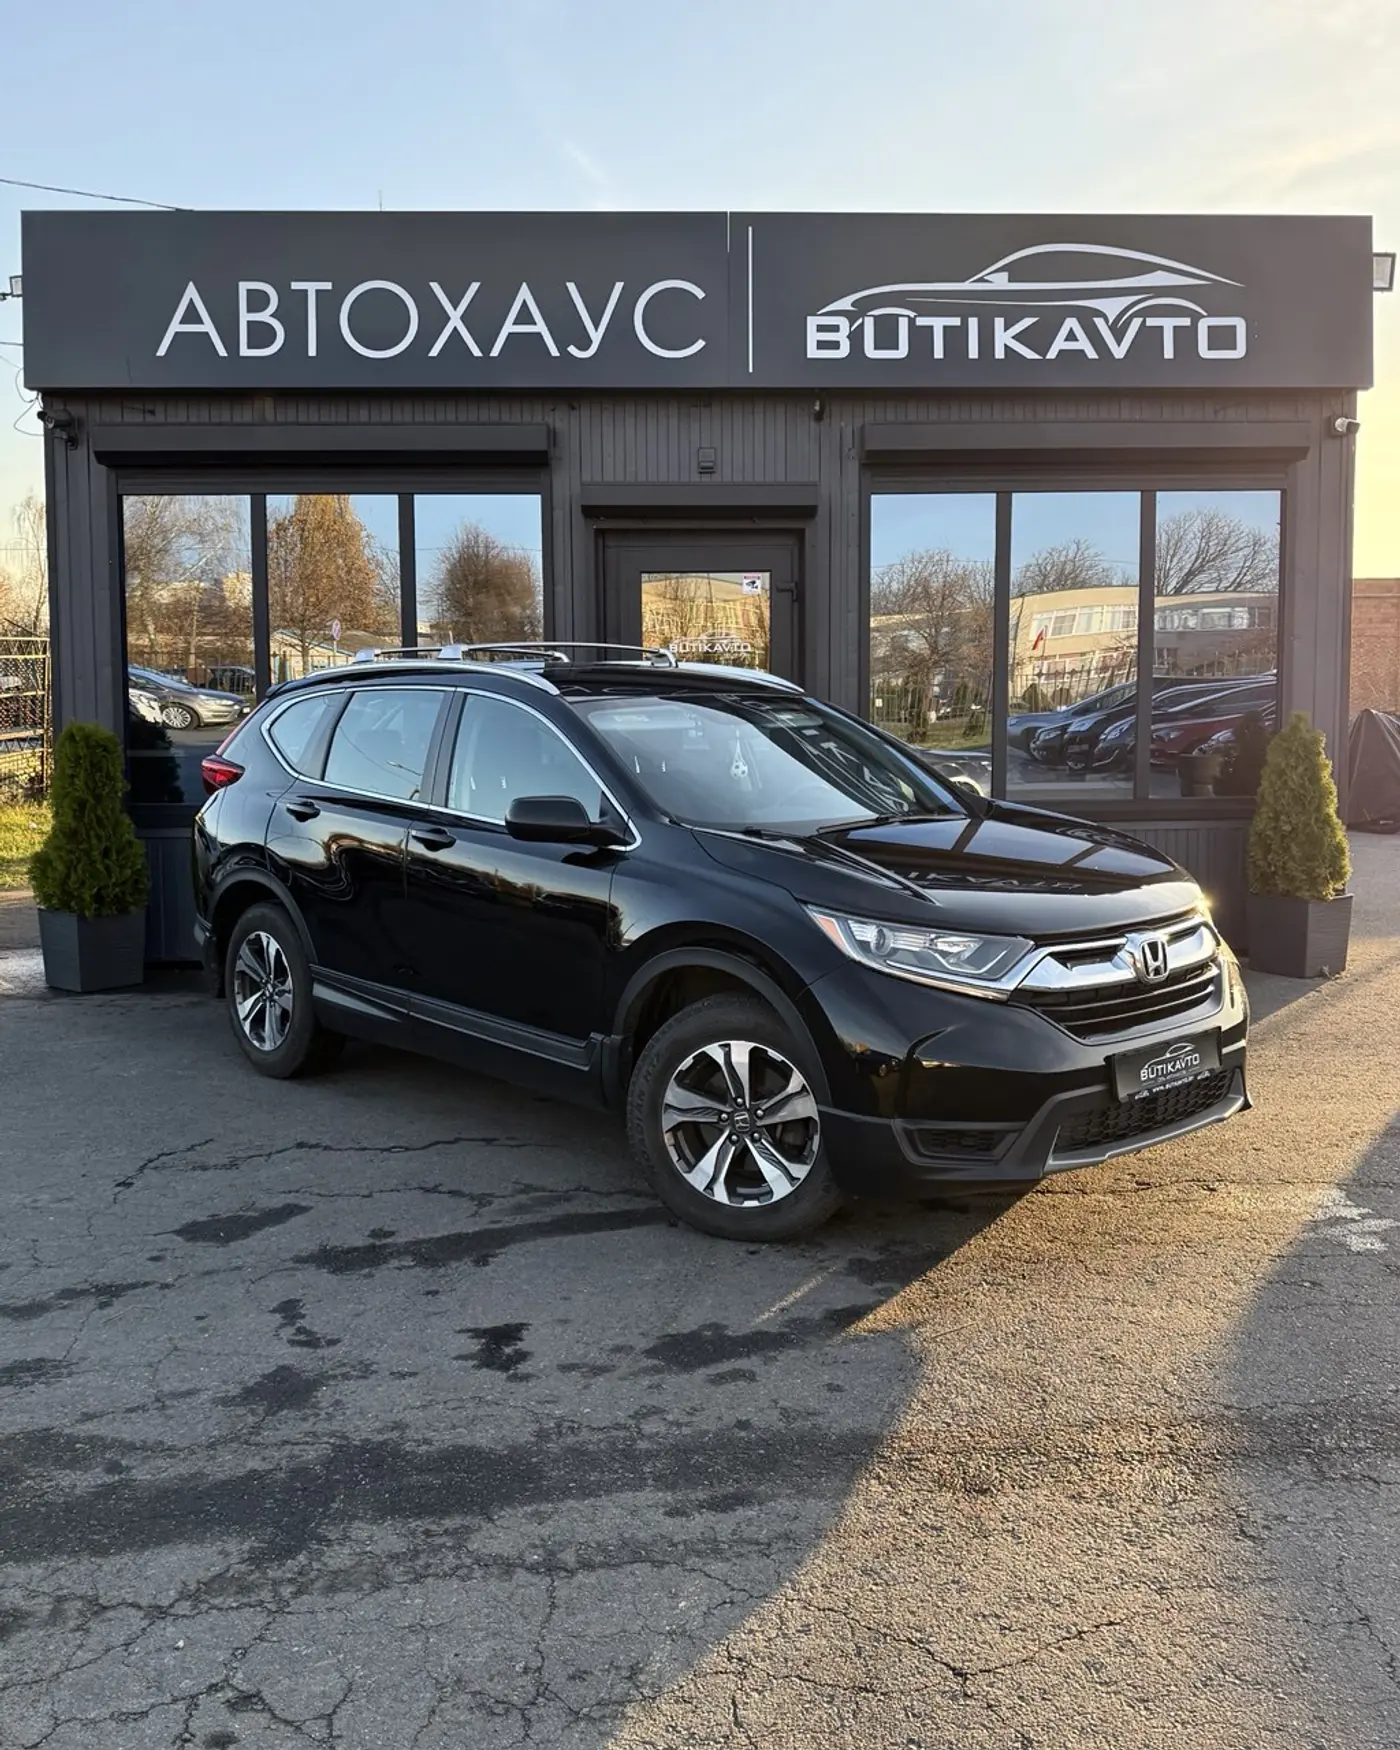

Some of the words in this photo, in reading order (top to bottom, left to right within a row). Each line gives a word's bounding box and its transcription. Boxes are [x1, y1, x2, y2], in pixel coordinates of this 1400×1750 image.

[157, 279, 706, 359] АВТОХАУС
[806, 315, 1247, 360] BUTIKAVTO
[669, 642, 751, 653] BUTIKAVTO
[1140, 1053, 1200, 1081] BUTIKAVTO
